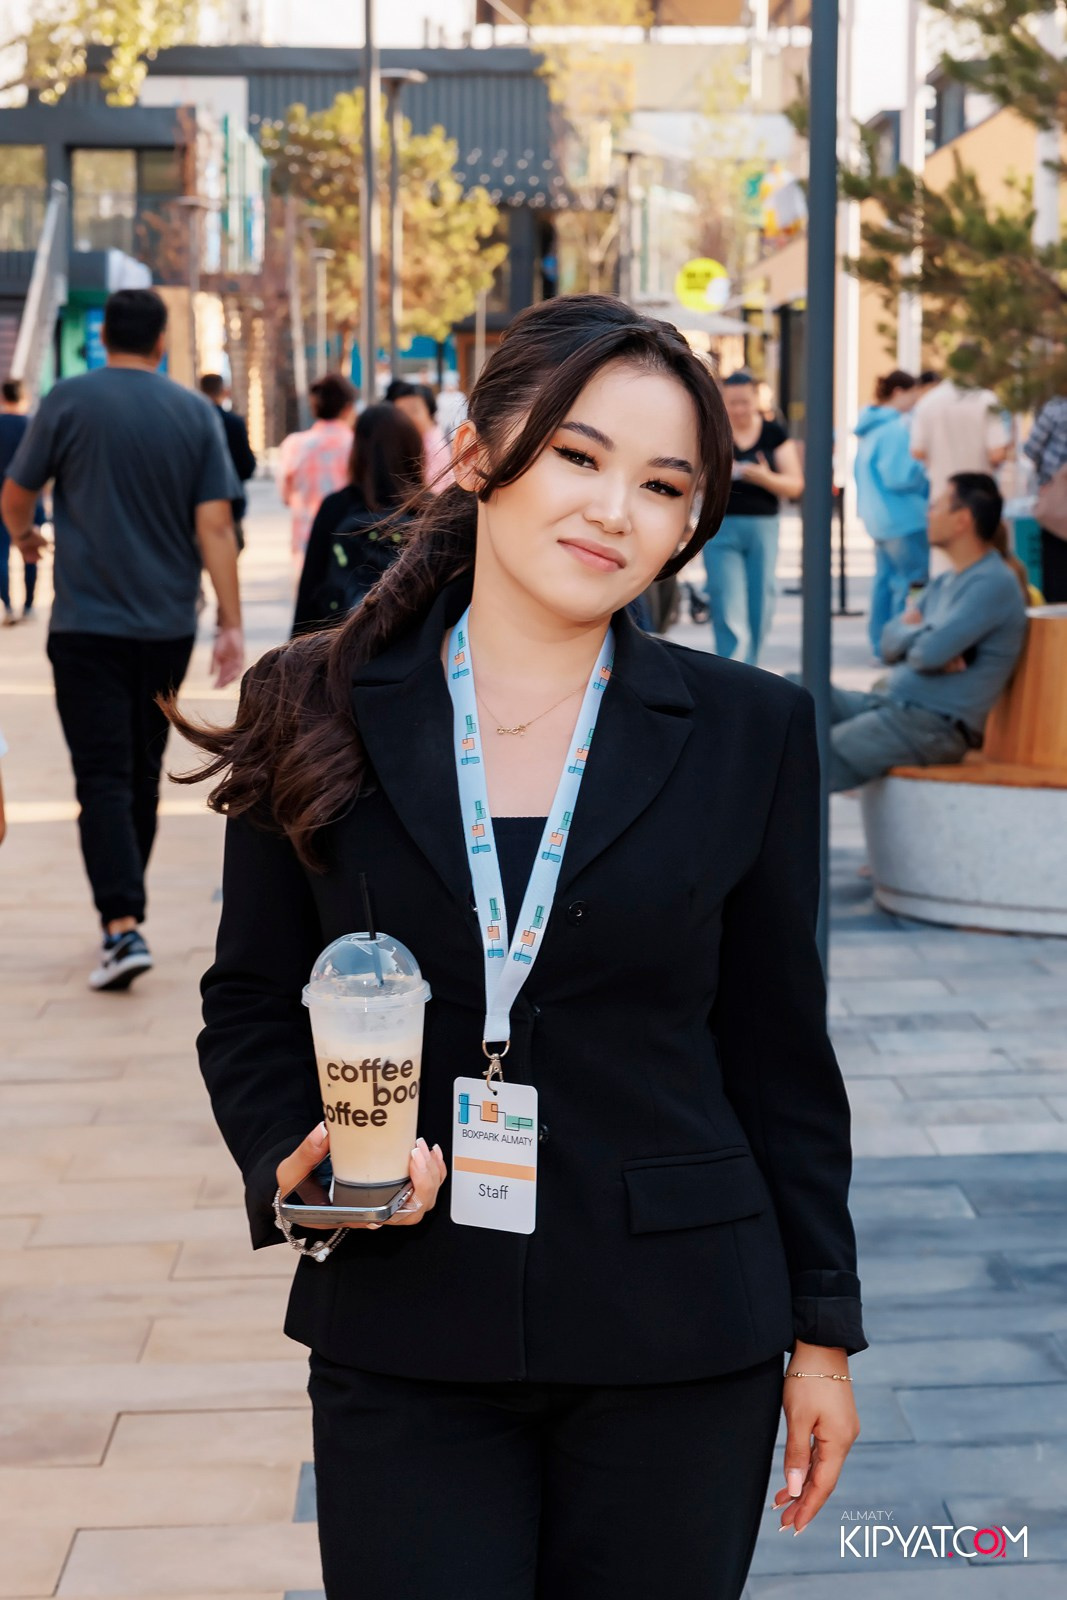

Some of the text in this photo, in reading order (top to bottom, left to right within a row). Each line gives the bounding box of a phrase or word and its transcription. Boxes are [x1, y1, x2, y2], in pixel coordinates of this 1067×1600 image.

[326, 1058, 414, 1083] coffee
[462, 1128, 533, 1147] BOXPARK ALMATY
[478, 1183, 509, 1200] Staff
